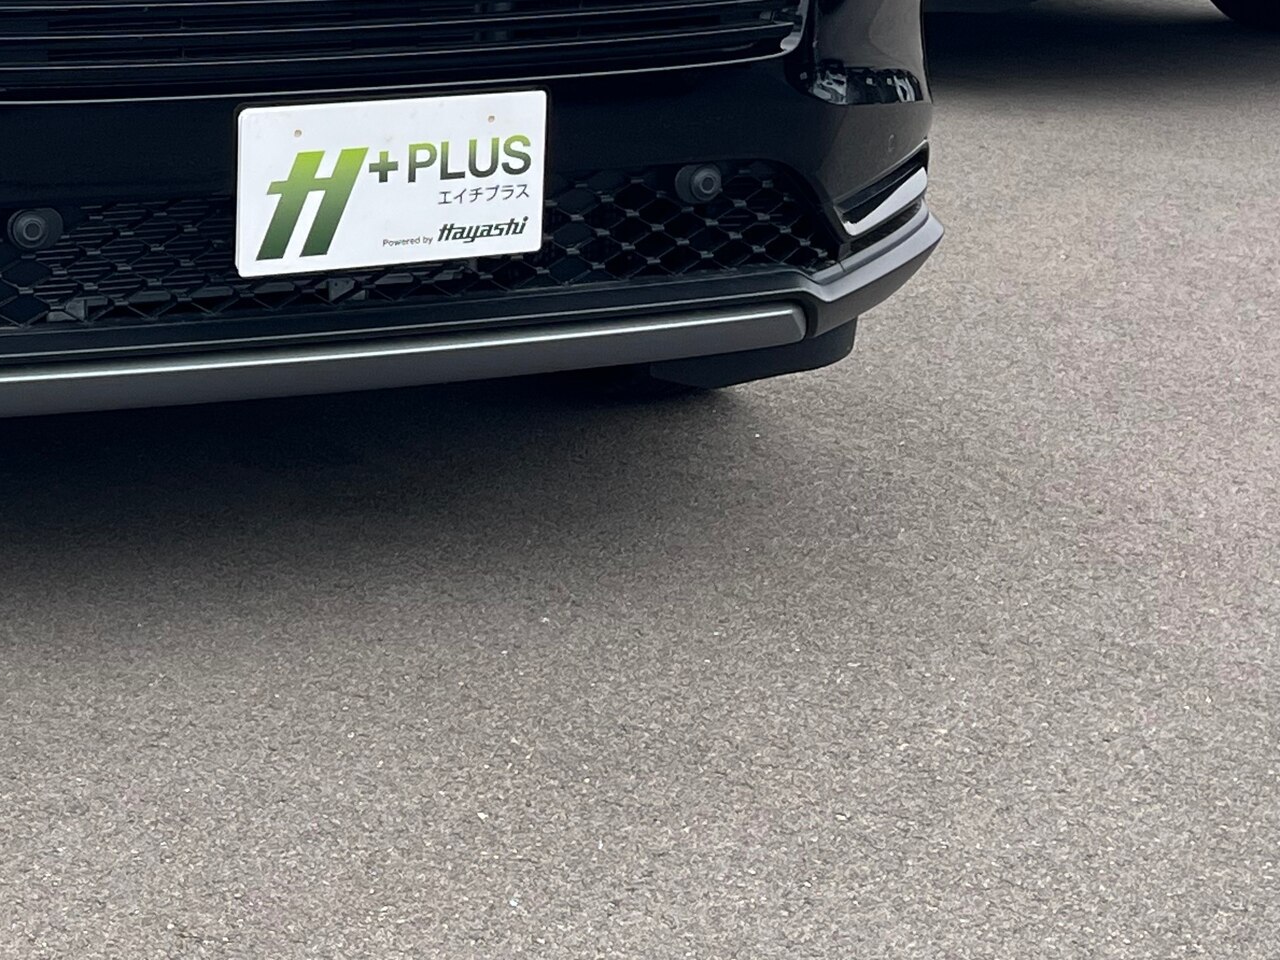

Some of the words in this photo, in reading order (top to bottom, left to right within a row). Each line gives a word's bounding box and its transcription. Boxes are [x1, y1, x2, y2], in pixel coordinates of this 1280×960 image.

[437, 183, 530, 205] エイチプラス
[382, 236, 421, 247] Powered
[422, 235, 433, 246] by
[437, 216, 530, 244] Hayashi
